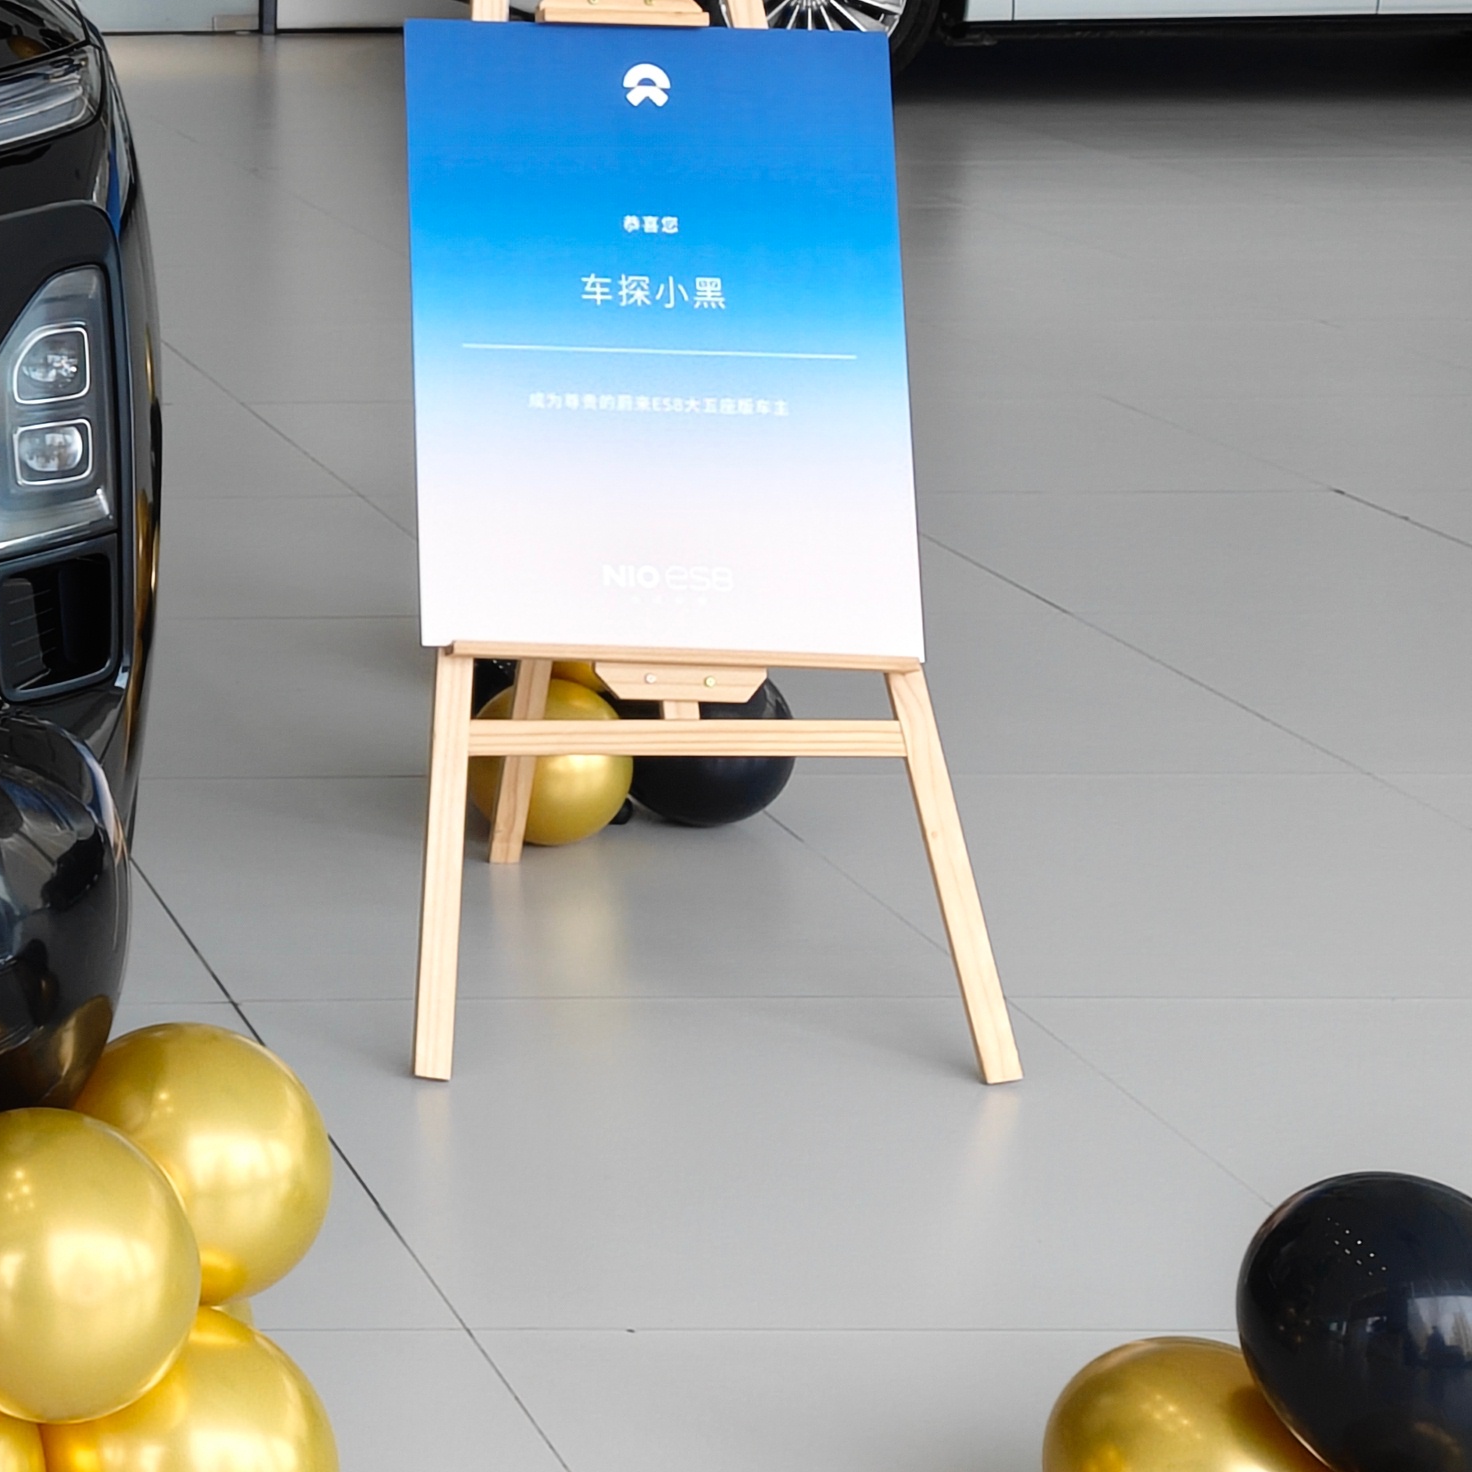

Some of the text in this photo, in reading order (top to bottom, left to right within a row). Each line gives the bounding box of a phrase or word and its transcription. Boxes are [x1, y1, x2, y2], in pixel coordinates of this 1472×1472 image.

[622, 214, 680, 235] 恭喜您
[580, 272, 726, 310] 车探小黑
[601, 563, 661, 590] NIO
